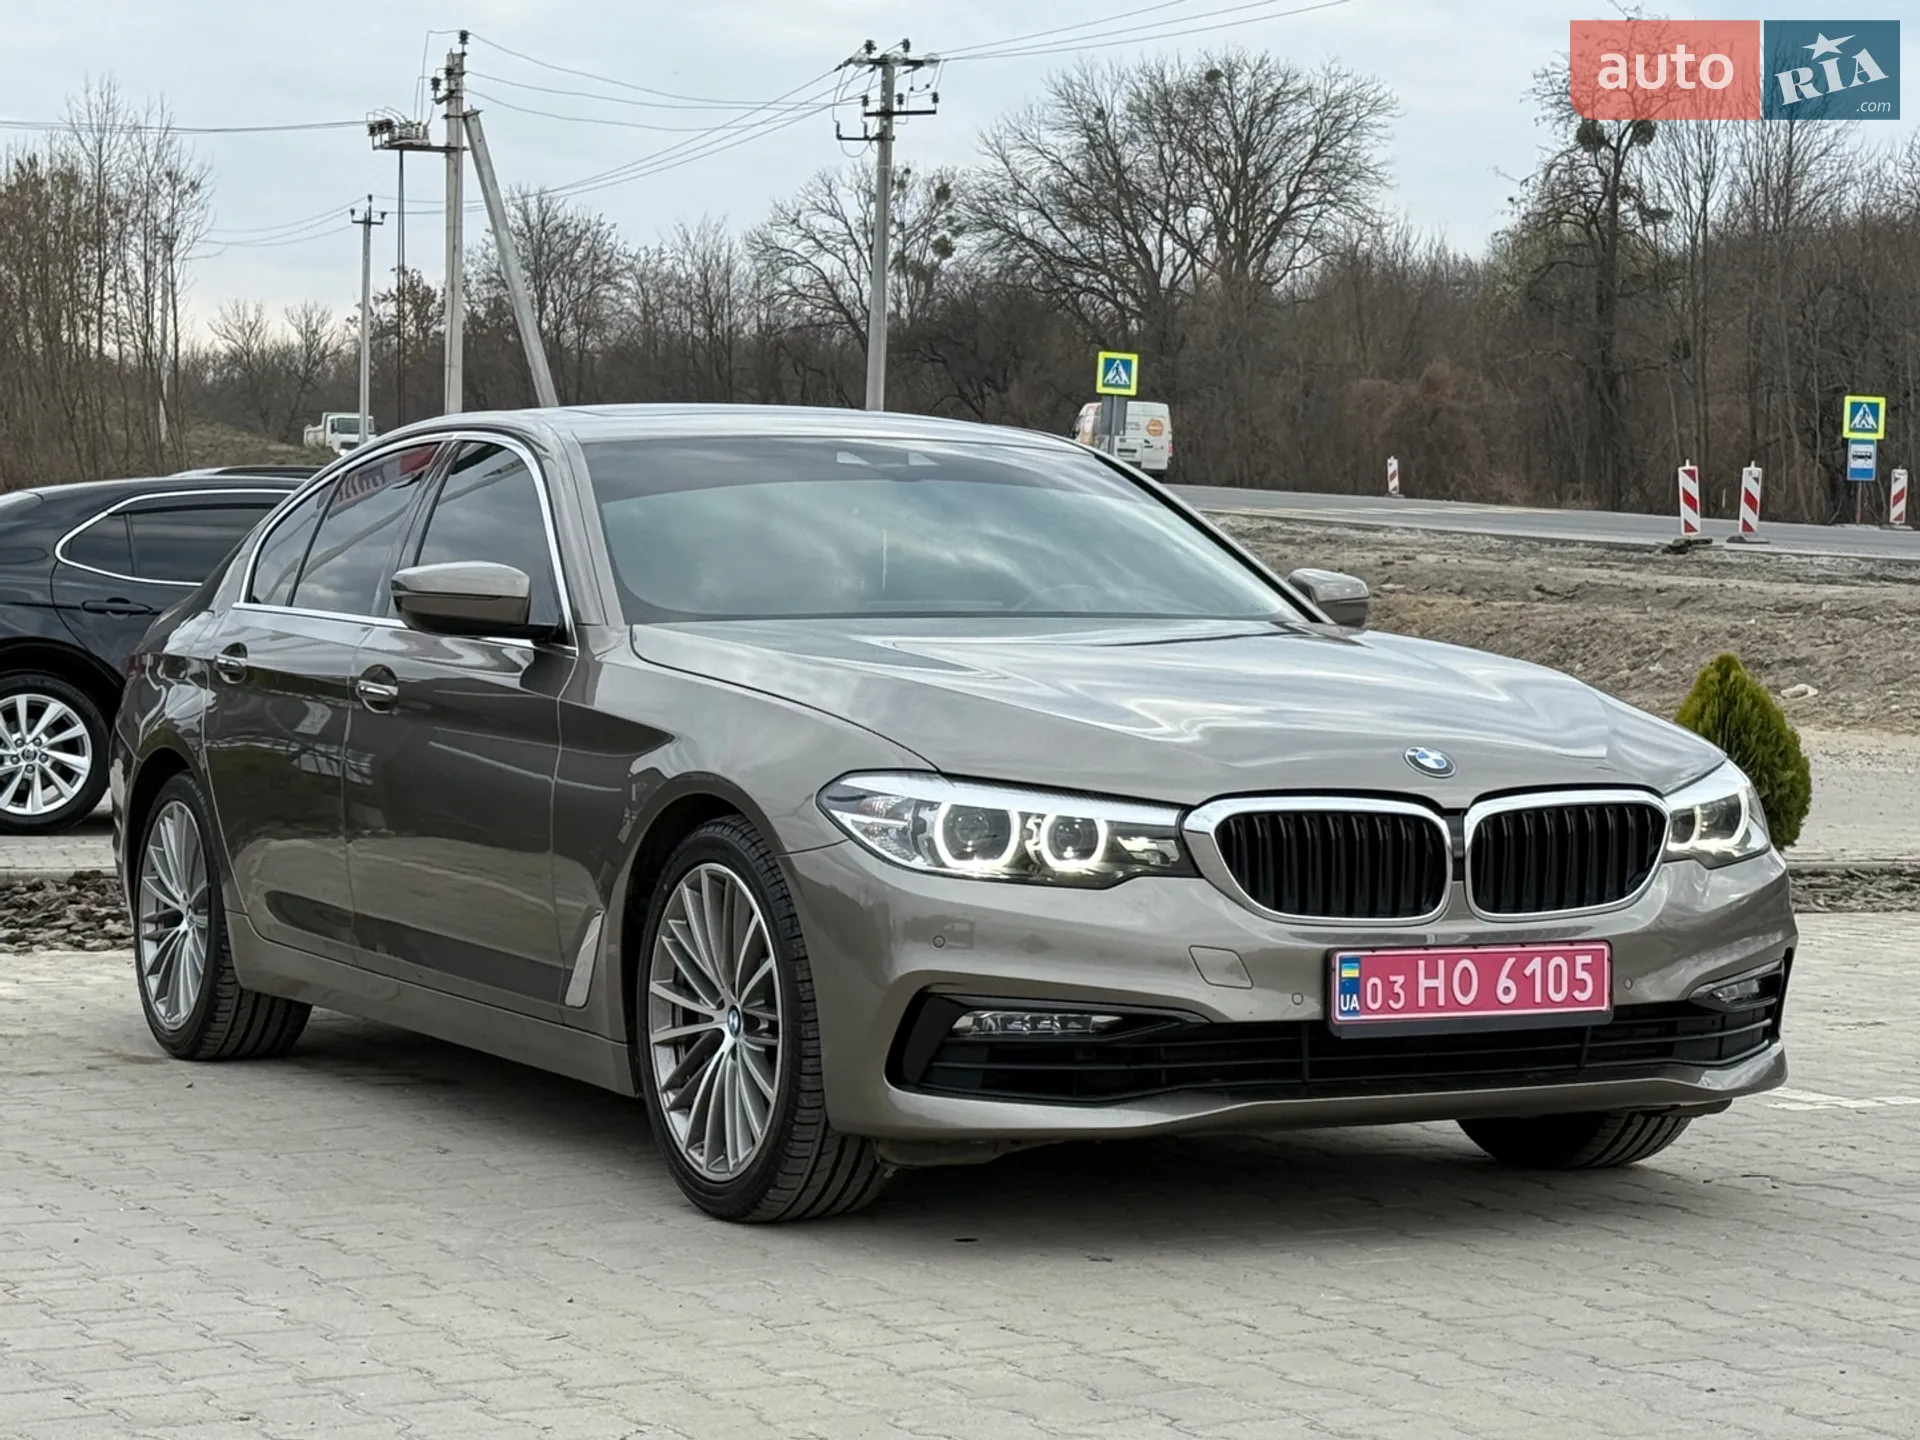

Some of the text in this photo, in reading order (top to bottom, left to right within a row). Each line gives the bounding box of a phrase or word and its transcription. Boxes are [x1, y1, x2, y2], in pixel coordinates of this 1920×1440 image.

[1340, 954, 1594, 1011] UA 03 HO 6105
